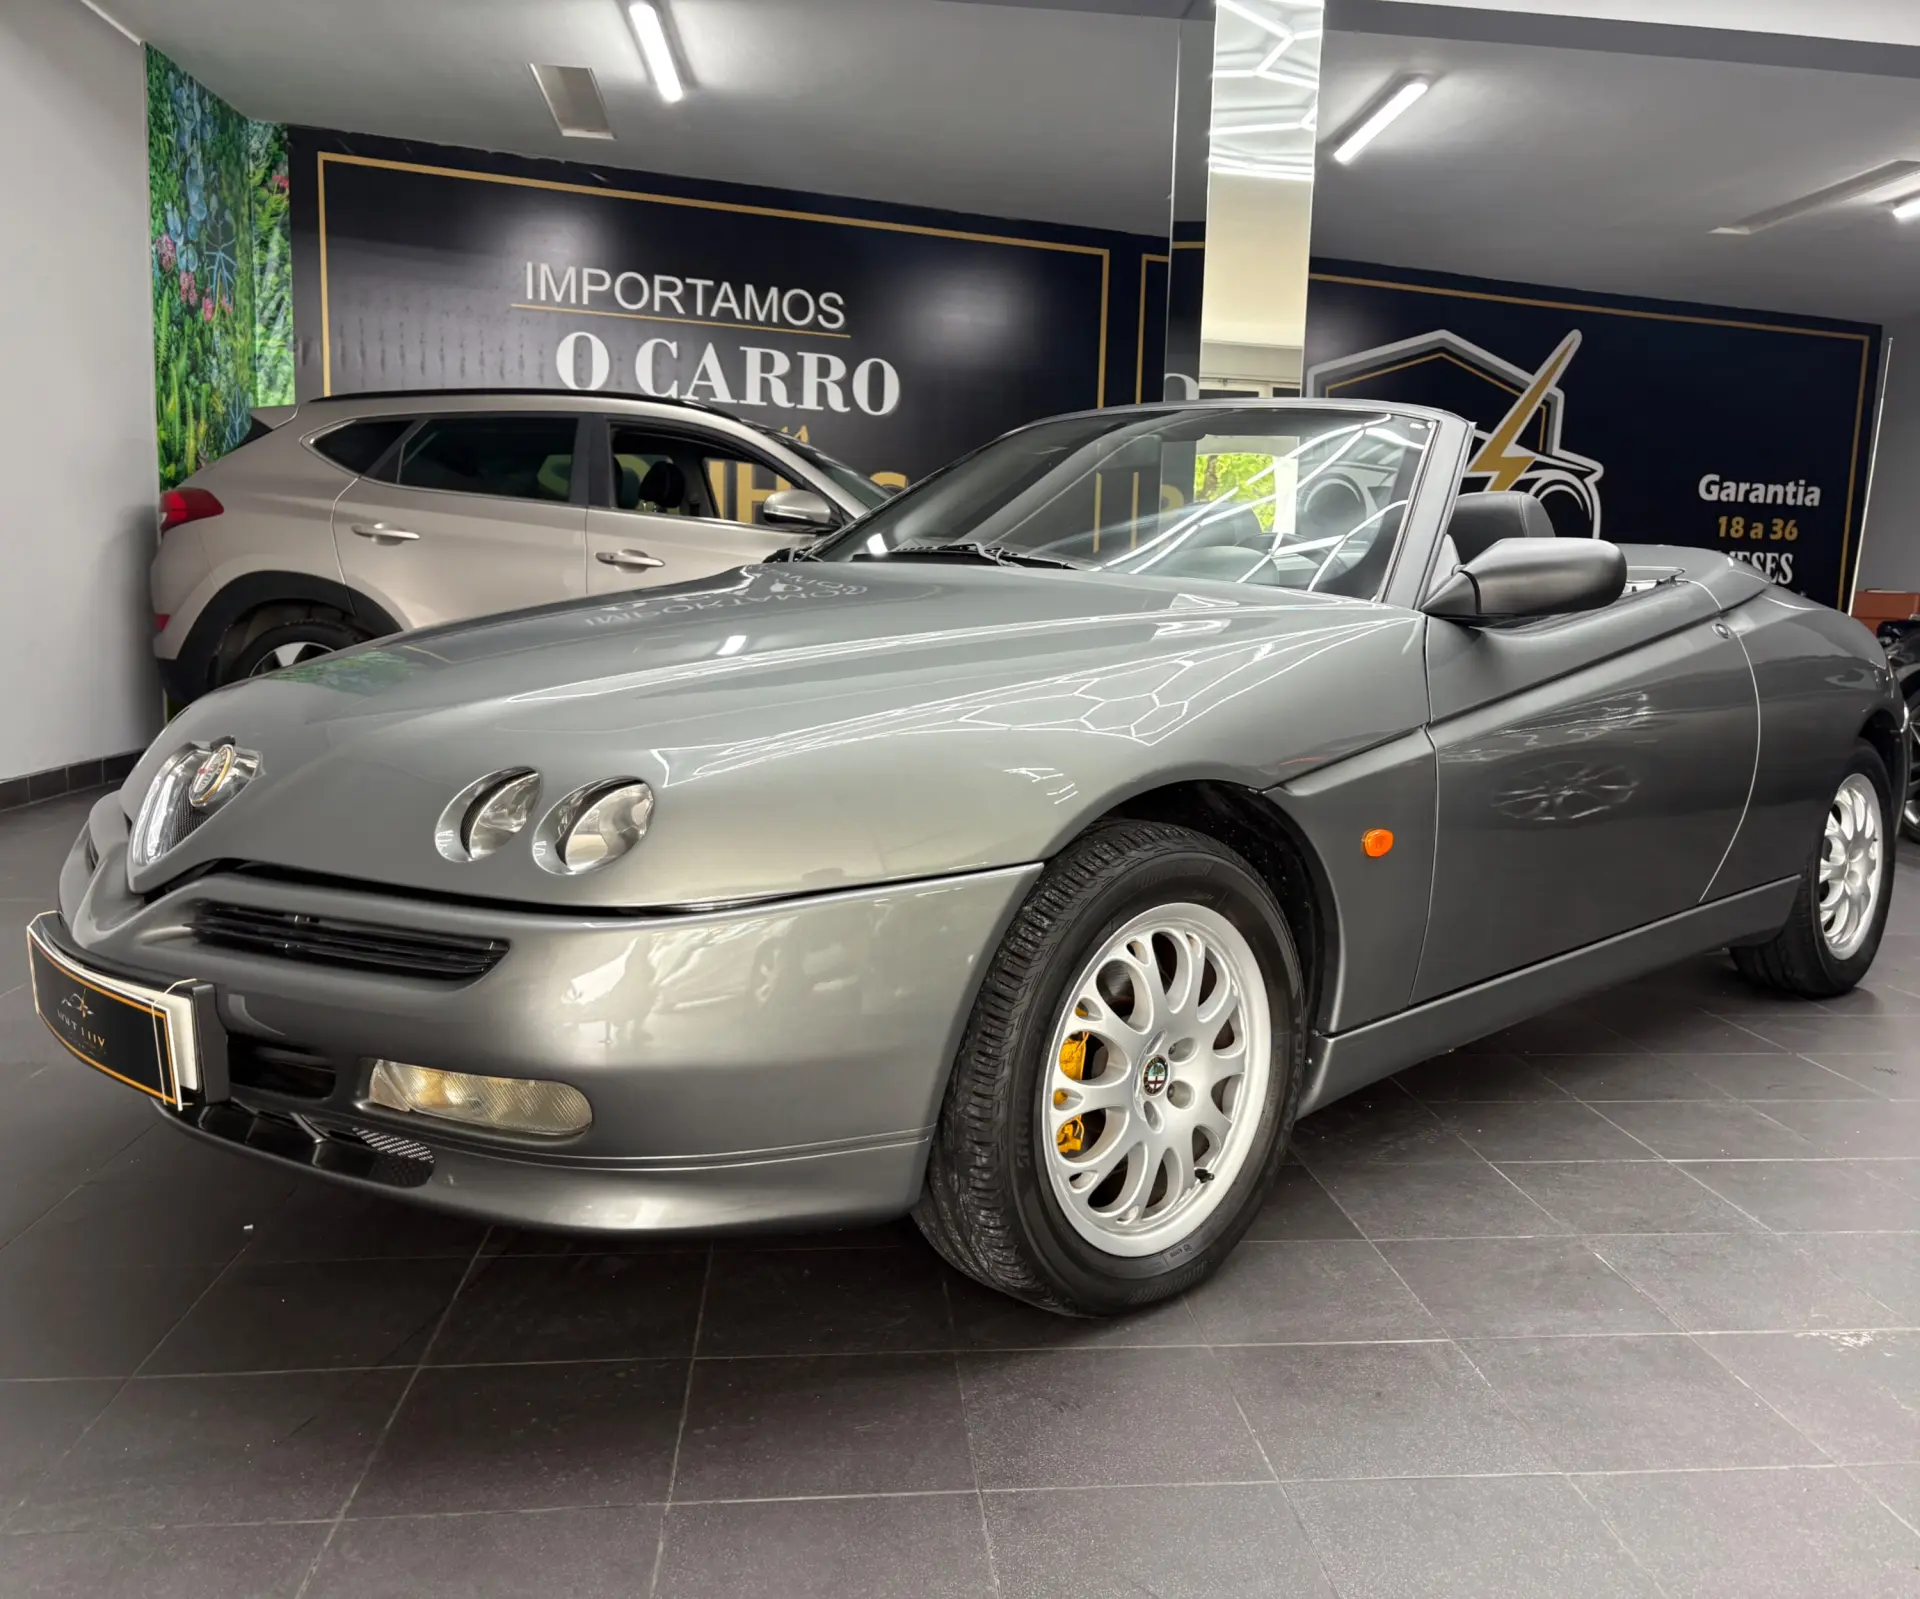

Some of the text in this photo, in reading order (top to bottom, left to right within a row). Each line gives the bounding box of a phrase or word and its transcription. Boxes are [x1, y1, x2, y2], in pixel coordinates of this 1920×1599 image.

[525, 262, 845, 329] IMPORTAMOS
[556, 331, 900, 417] O CARRO
[1698, 473, 1822, 507] Garantia
[1718, 515, 1798, 541] 18 a 36
[1729, 550, 1794, 585] SES
